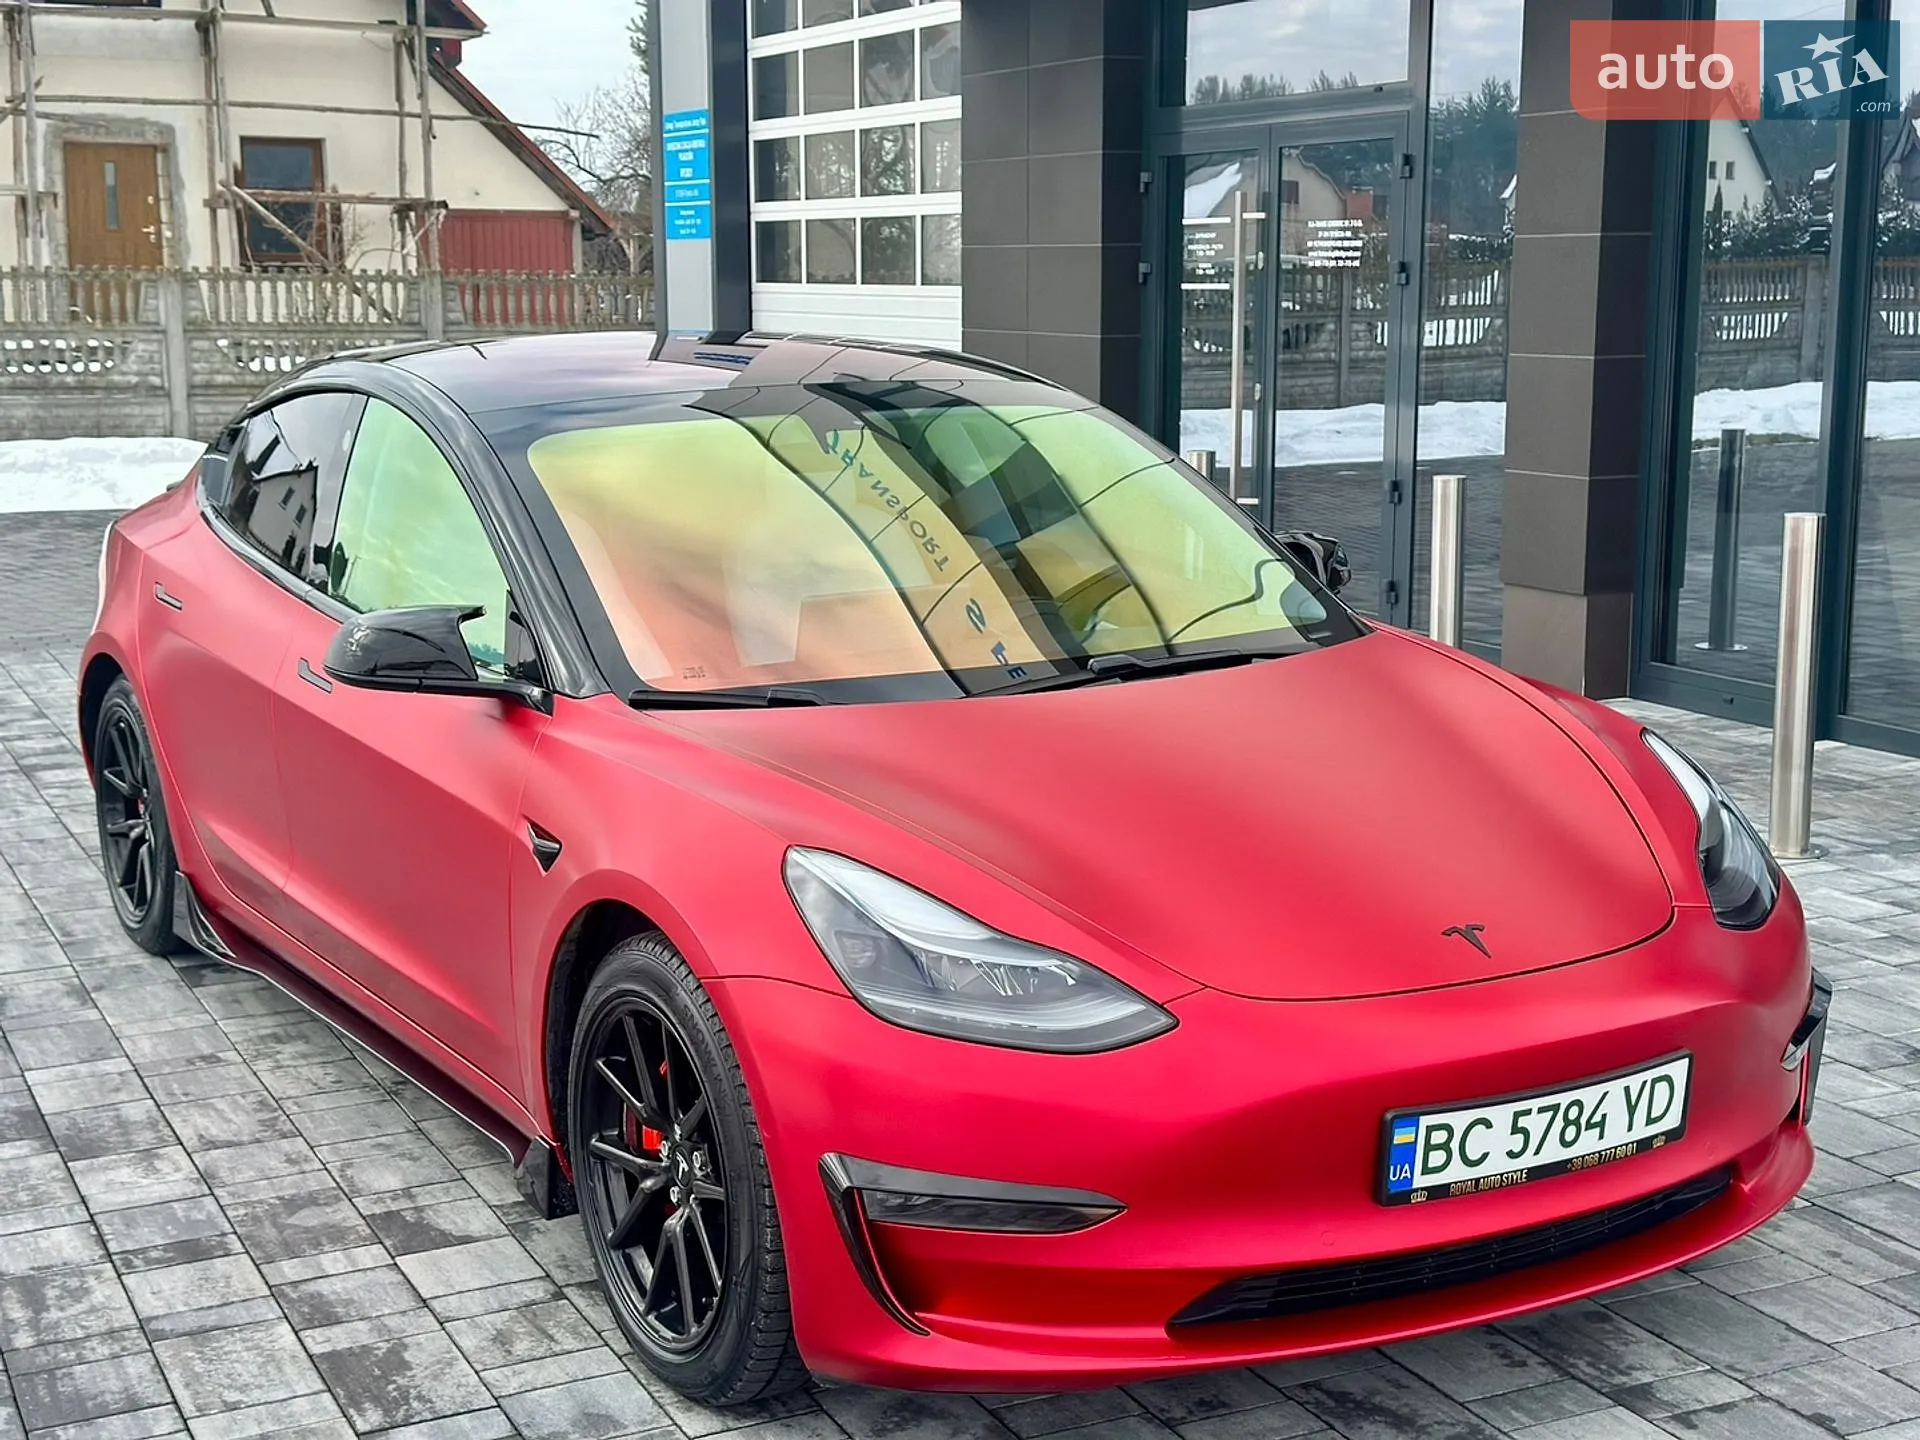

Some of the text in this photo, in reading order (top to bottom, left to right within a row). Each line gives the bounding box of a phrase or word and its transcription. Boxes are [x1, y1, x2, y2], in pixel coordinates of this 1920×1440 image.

[1420, 1074, 1675, 1176] BC 5784 YD
[1600, 1149, 1615, 1163] 777
[1389, 1164, 1411, 1182] UA
[1449, 1169, 1528, 1196] ROYAL AUTO STYLE
